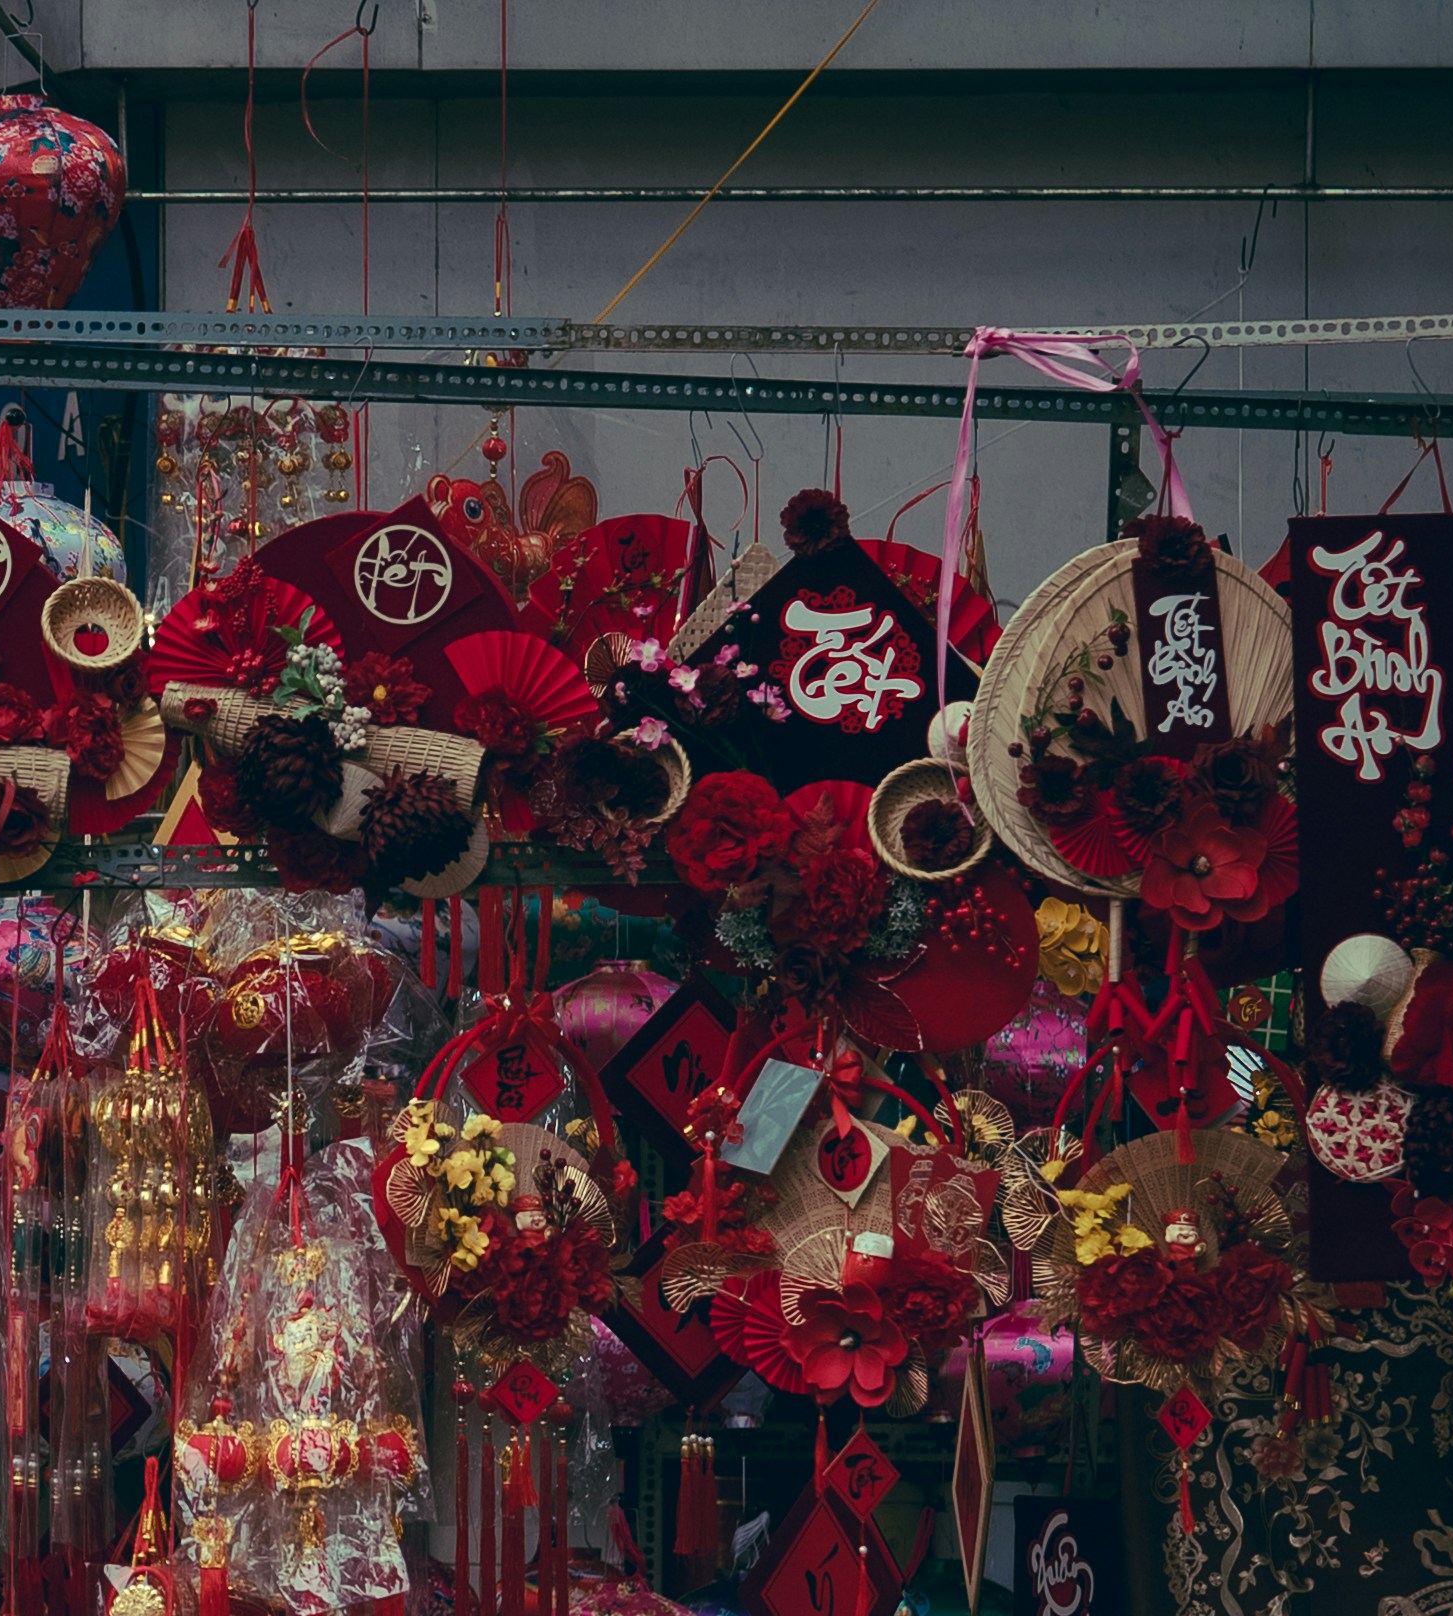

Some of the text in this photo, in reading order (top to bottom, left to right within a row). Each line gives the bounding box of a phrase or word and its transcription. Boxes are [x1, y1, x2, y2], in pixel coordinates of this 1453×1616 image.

[1312, 530, 1423, 621] Tết
[785, 600, 921, 728] Tết
[1148, 591, 1216, 657] Tết
[1311, 620, 1441, 698] Bình
[1321, 692, 1442, 781] An
[845, 1454, 884, 1498] Tết
